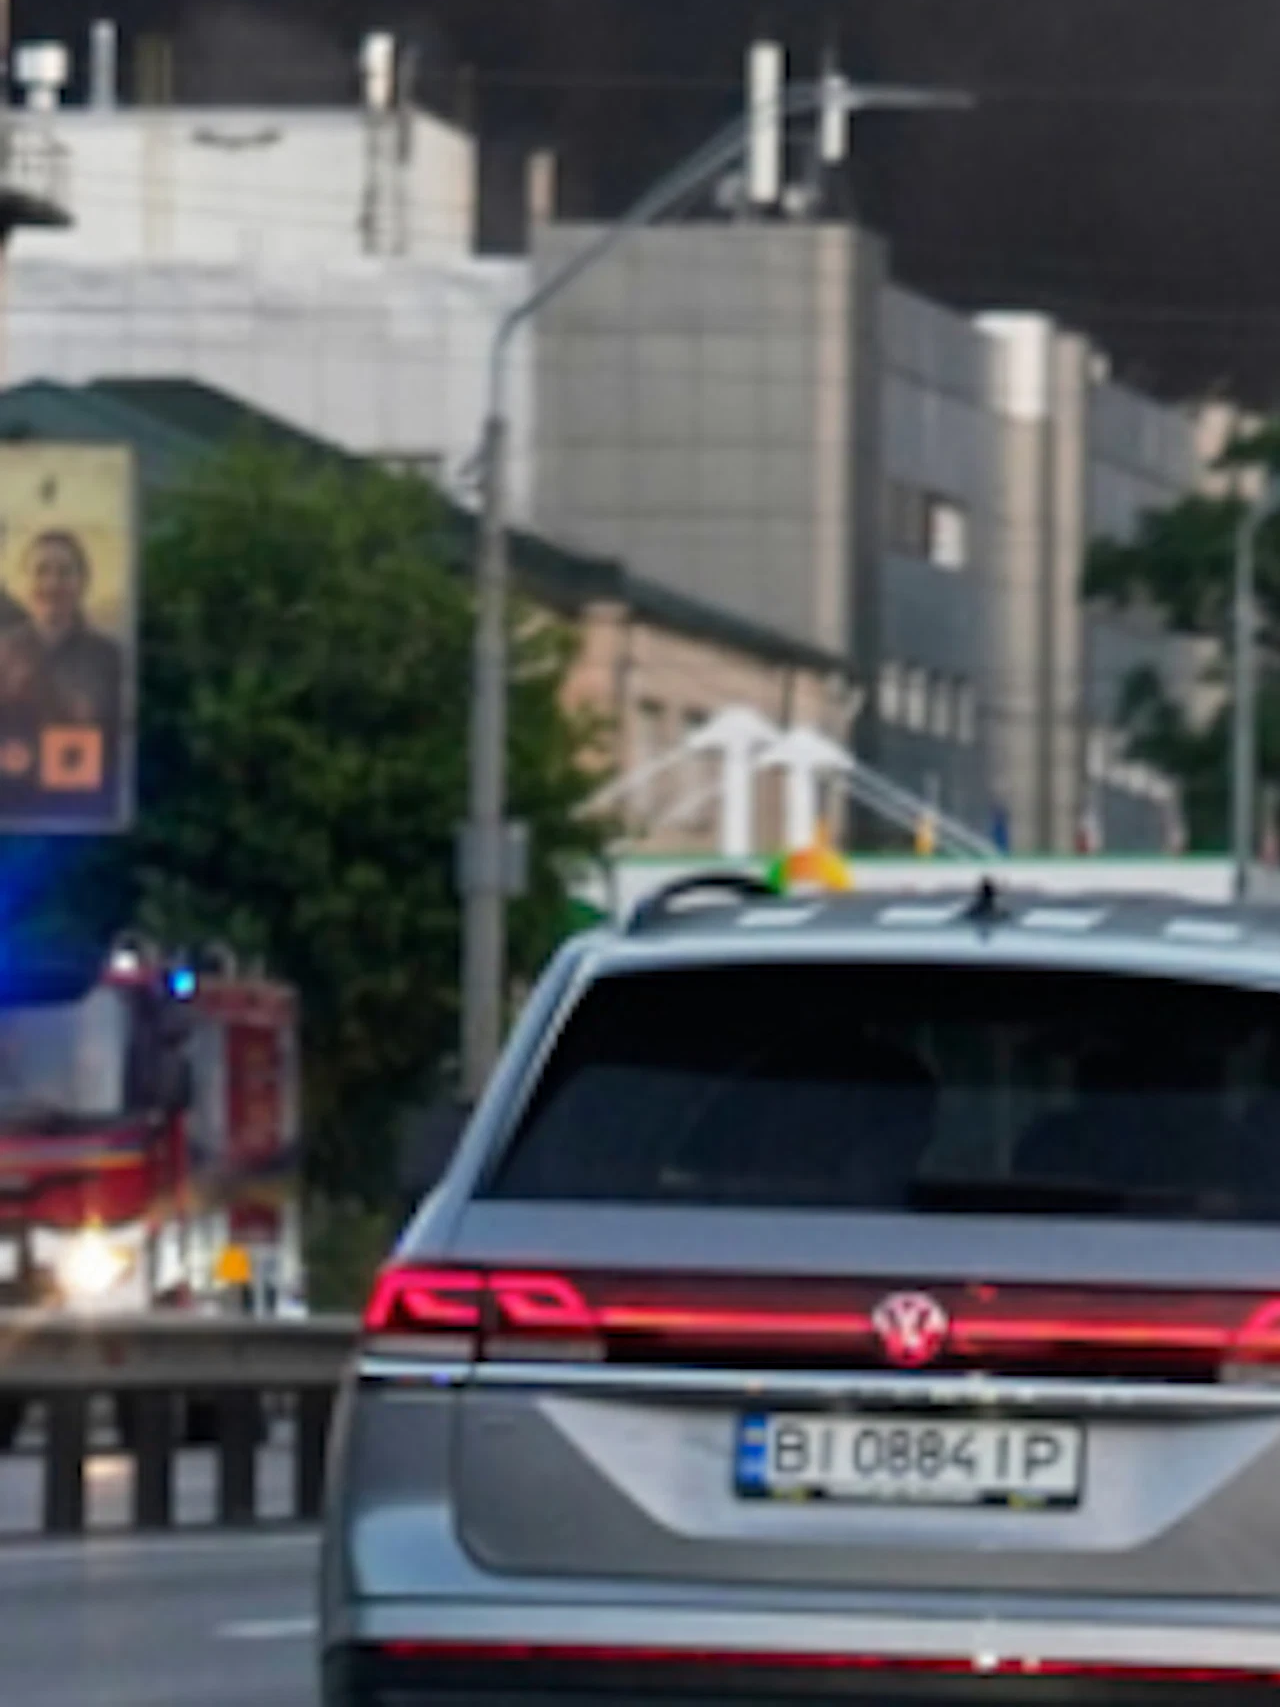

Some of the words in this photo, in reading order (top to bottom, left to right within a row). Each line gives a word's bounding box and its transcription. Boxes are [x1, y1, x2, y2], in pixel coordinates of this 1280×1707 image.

[774, 1427, 833, 1474] BI
[853, 1429, 977, 1480] 0884
[995, 1431, 1062, 1481] IP
